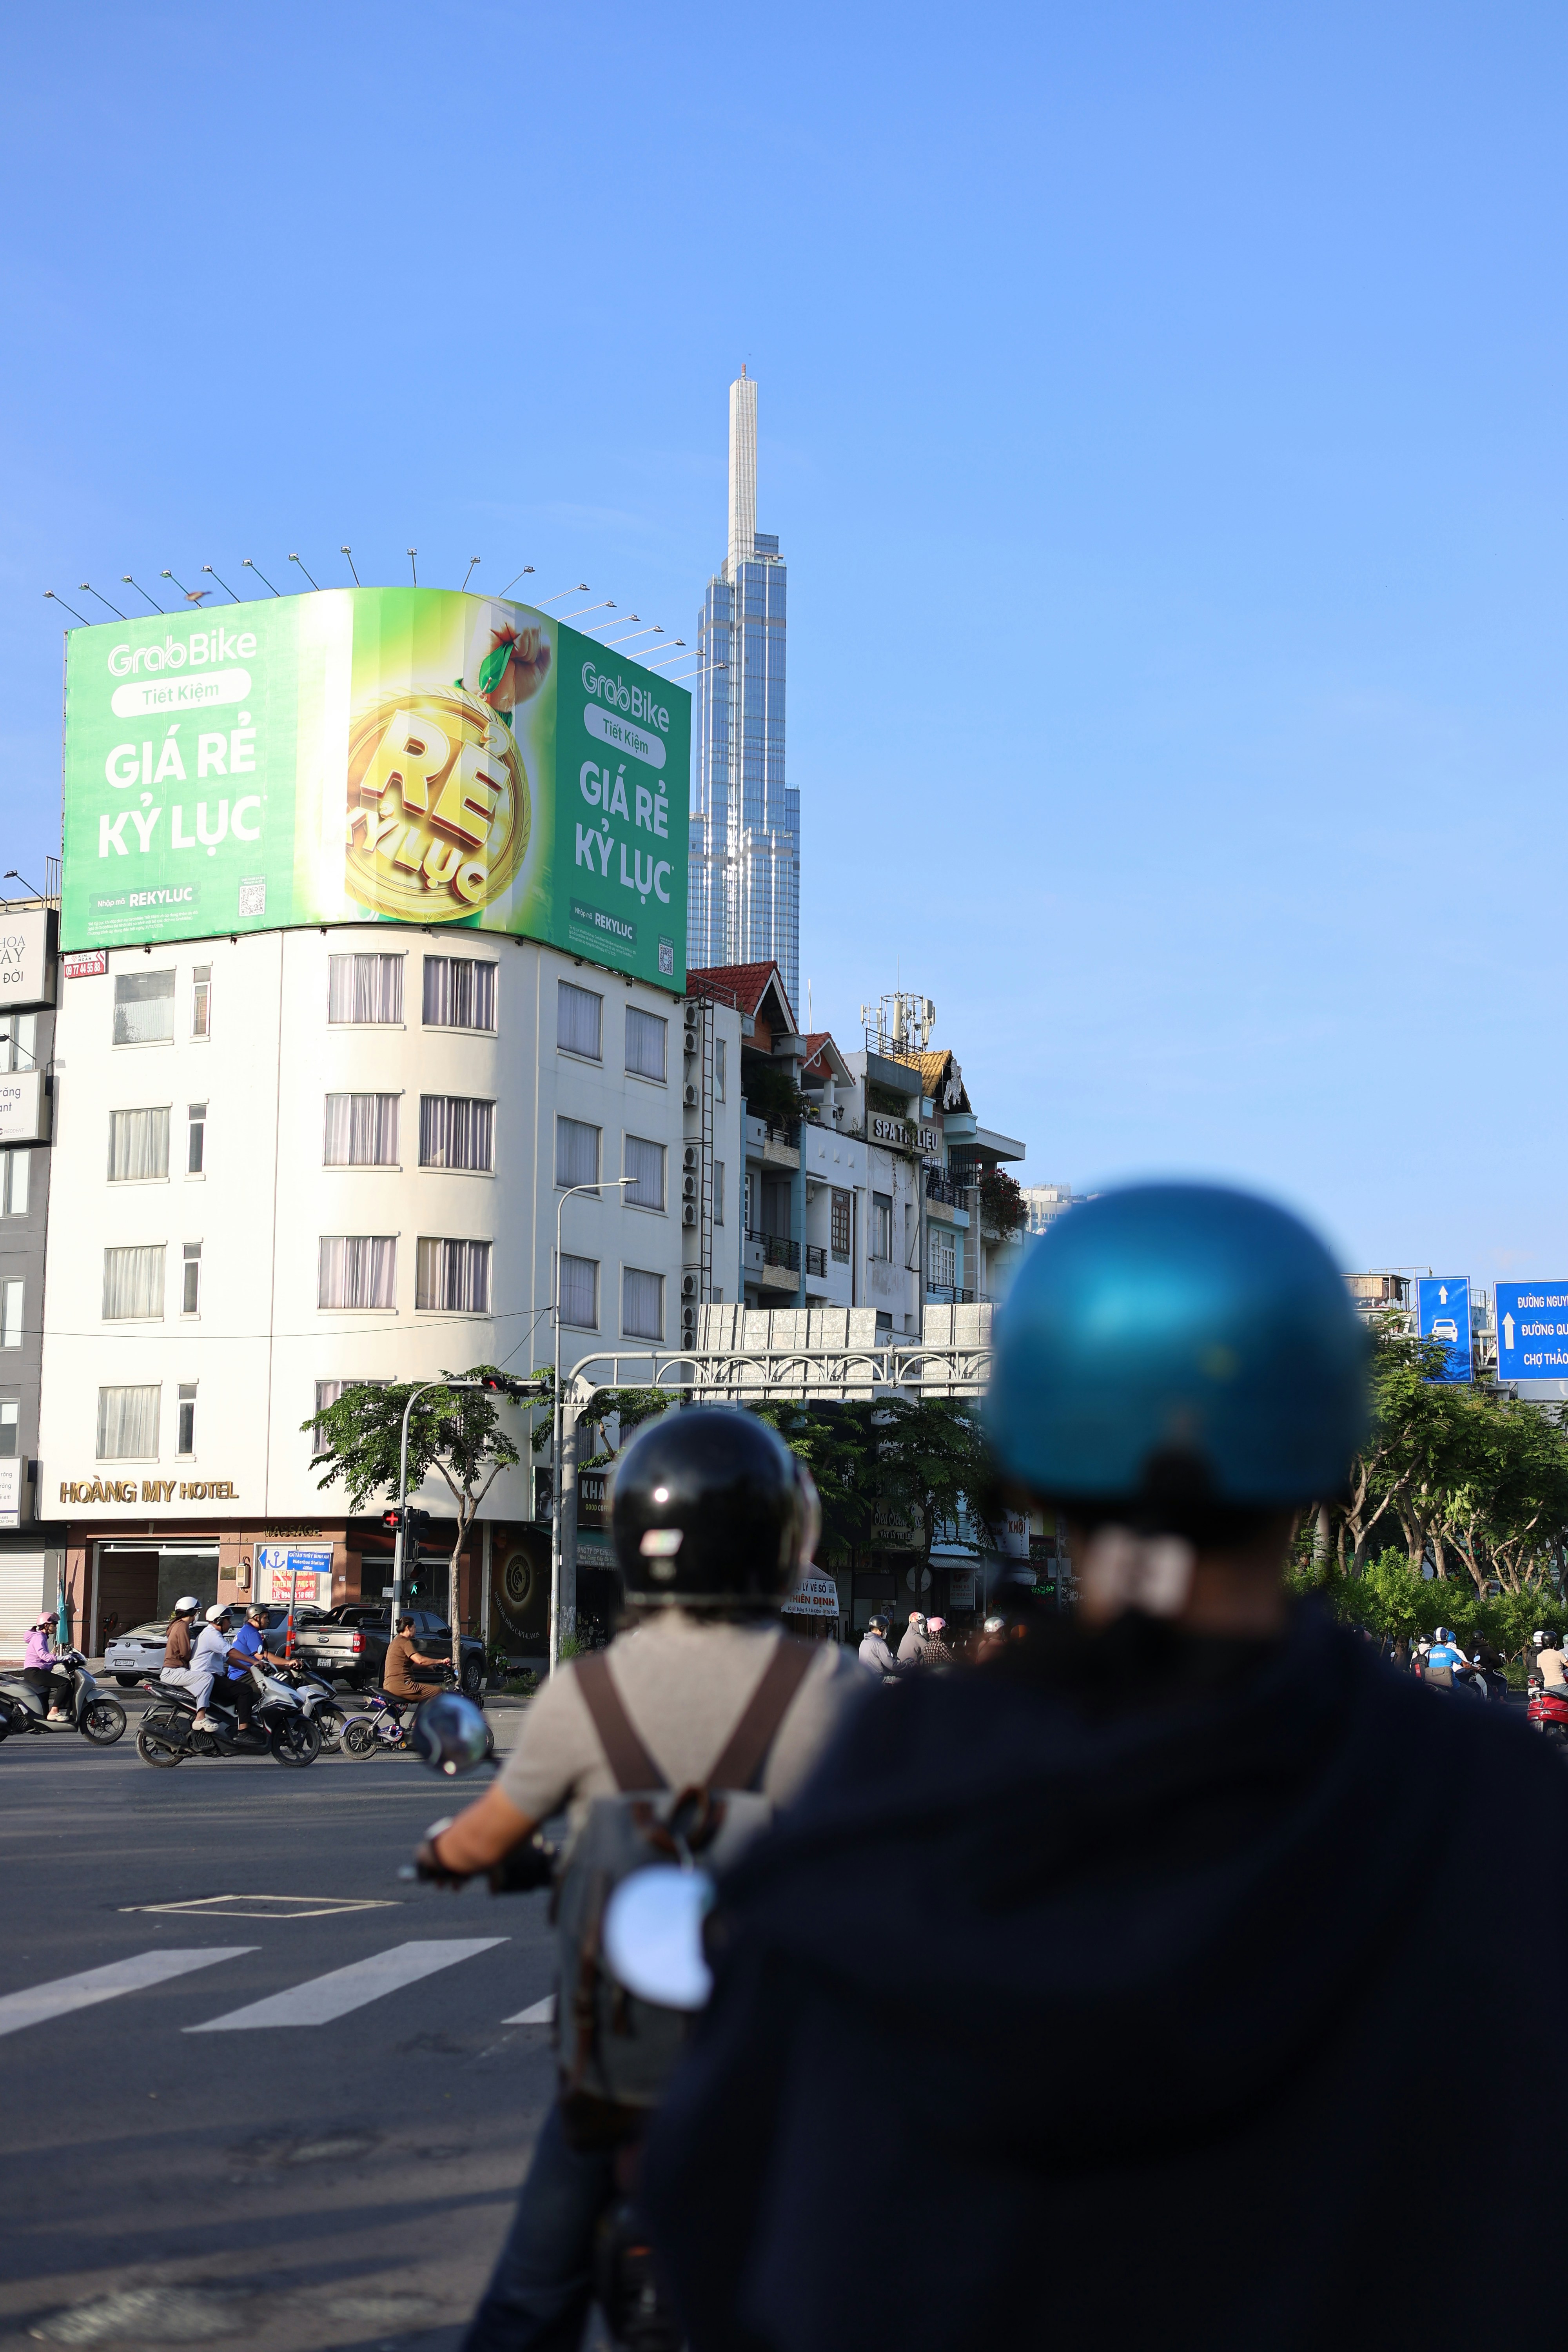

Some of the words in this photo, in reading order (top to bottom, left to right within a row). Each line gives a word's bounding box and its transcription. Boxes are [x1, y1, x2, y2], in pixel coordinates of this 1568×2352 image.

[107, 627, 257, 677] GrabBike
[142, 686, 173, 705] Tiết
[178, 682, 219, 702] Kiệm
[582, 661, 669, 732] GrabBike
[603, 718, 622, 742] Tiết
[624, 729, 648, 755] Kiệm
[105, 724, 187, 789] GIÁ
[198, 711, 256, 778] RẺ
[360, 709, 510, 848] RẺ
[580, 761, 630, 822] GIÁ
[635, 780, 668, 839] RẺ
[99, 791, 162, 858] KỶ
[575, 818, 615, 877] KỶ
[394, 826, 490, 904] LỤC
[98, 899, 114, 907] Nhập
[129, 887, 192, 907] REKYLUC
[575, 907, 586, 918] Nhập
[595, 912, 632, 940] REKYLUC
[0, 947, 26, 964] AY
[3, 969, 23, 984] ĐỜI
[66, 965, 72, 976] 09
[73, 965, 79, 975] 77
[80, 964, 86, 974] 44
[87, 963, 93, 973] 55
[94, 962, 100, 972] 88
[875, 1118, 896, 1141] SPA
[917, 1128, 938, 1153] LIỆU
[1518, 1292, 1544, 1308] ĐƯỜNG
[1546, 1294, 1568, 1307] NGUY
[1521, 1321, 1554, 1336] ĐƯỜNG
[1524, 1353, 1543, 1368] CHỢ
[1544, 1348, 1568, 1365] THẢO
[60, 1475, 137, 1503] HOÀNG
[142, 1480, 177, 1502] MY
[179, 1481, 240, 1499] HOTEL
[875, 1502, 888, 1525] Sea
[263, 1525, 321, 1537] MASSAGE
[802, 1581, 809, 1591] LÝ
[810, 1581, 817, 1592] VÉ
[818, 1581, 827, 1593] SỐ
[813, 1596, 835, 1608] ĐỊNH
